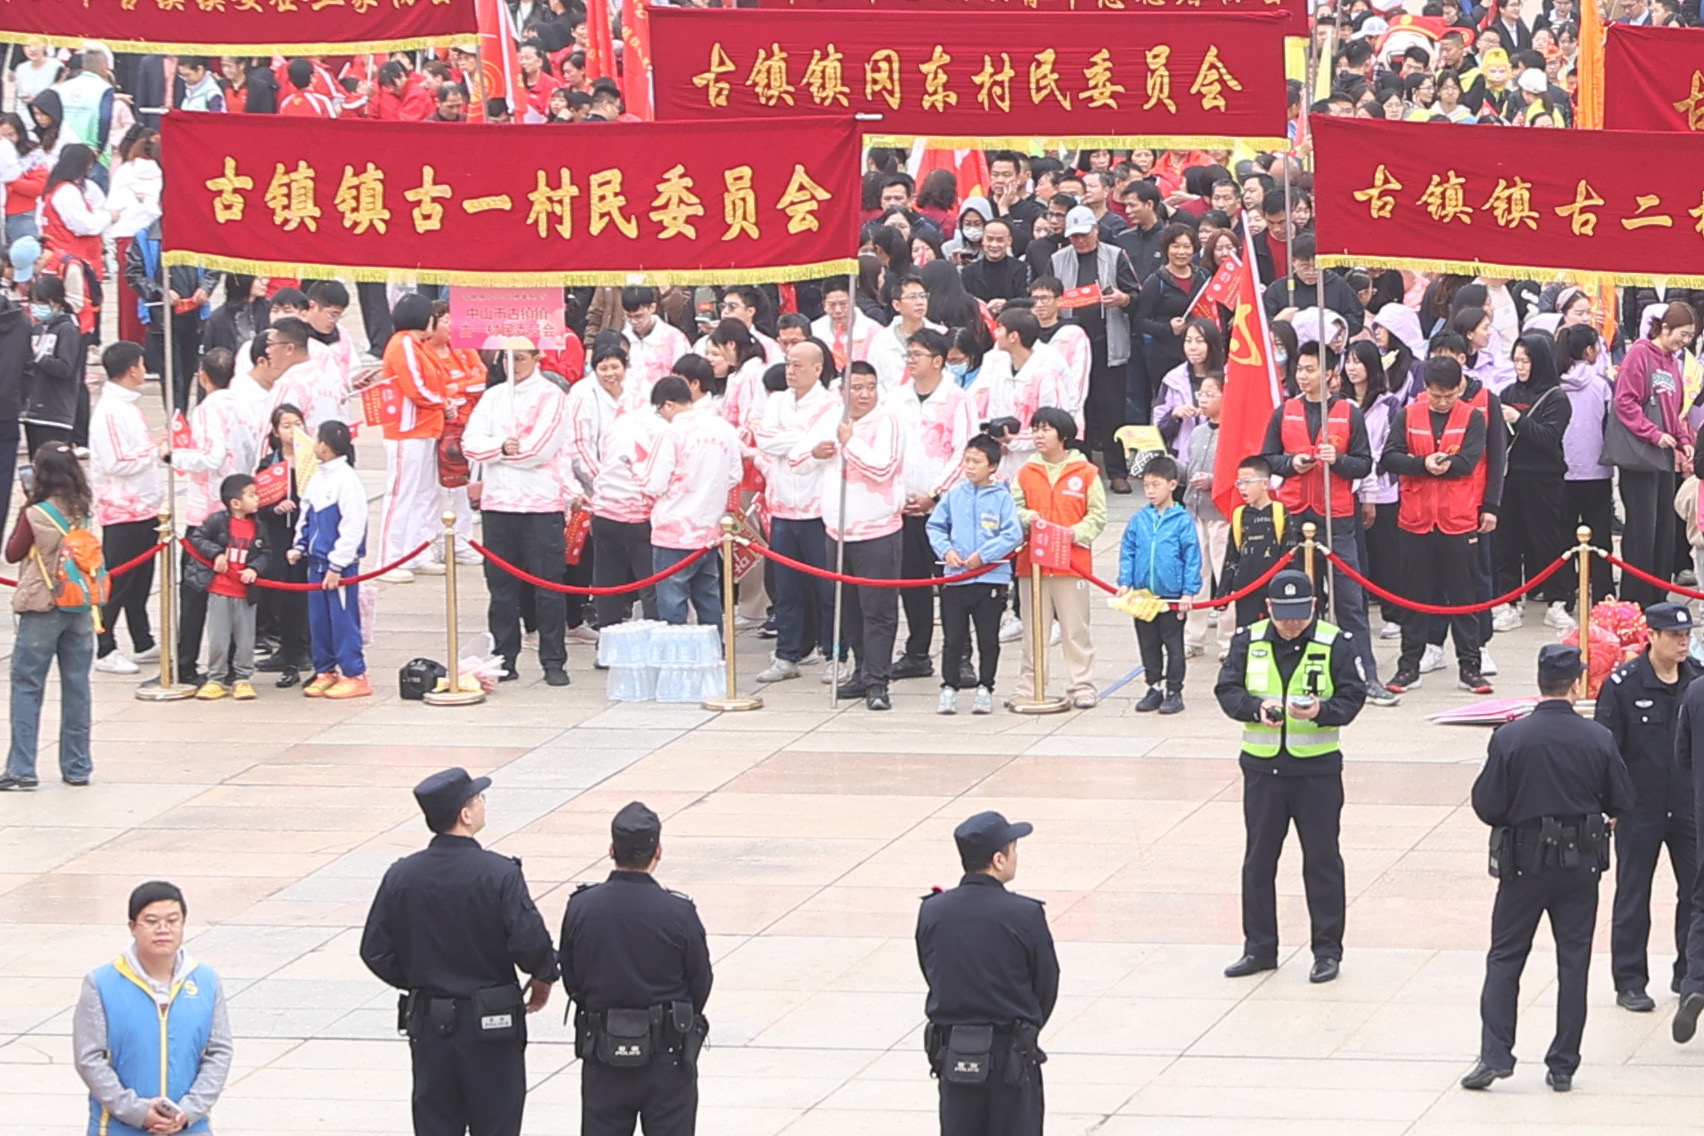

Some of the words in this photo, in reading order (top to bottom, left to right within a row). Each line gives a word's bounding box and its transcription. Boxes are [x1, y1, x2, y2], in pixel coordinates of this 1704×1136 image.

[692, 42, 1243, 114] 古镇镇冈东村民委员会
[205, 156, 832, 241] 古镇镇古一村民委员会
